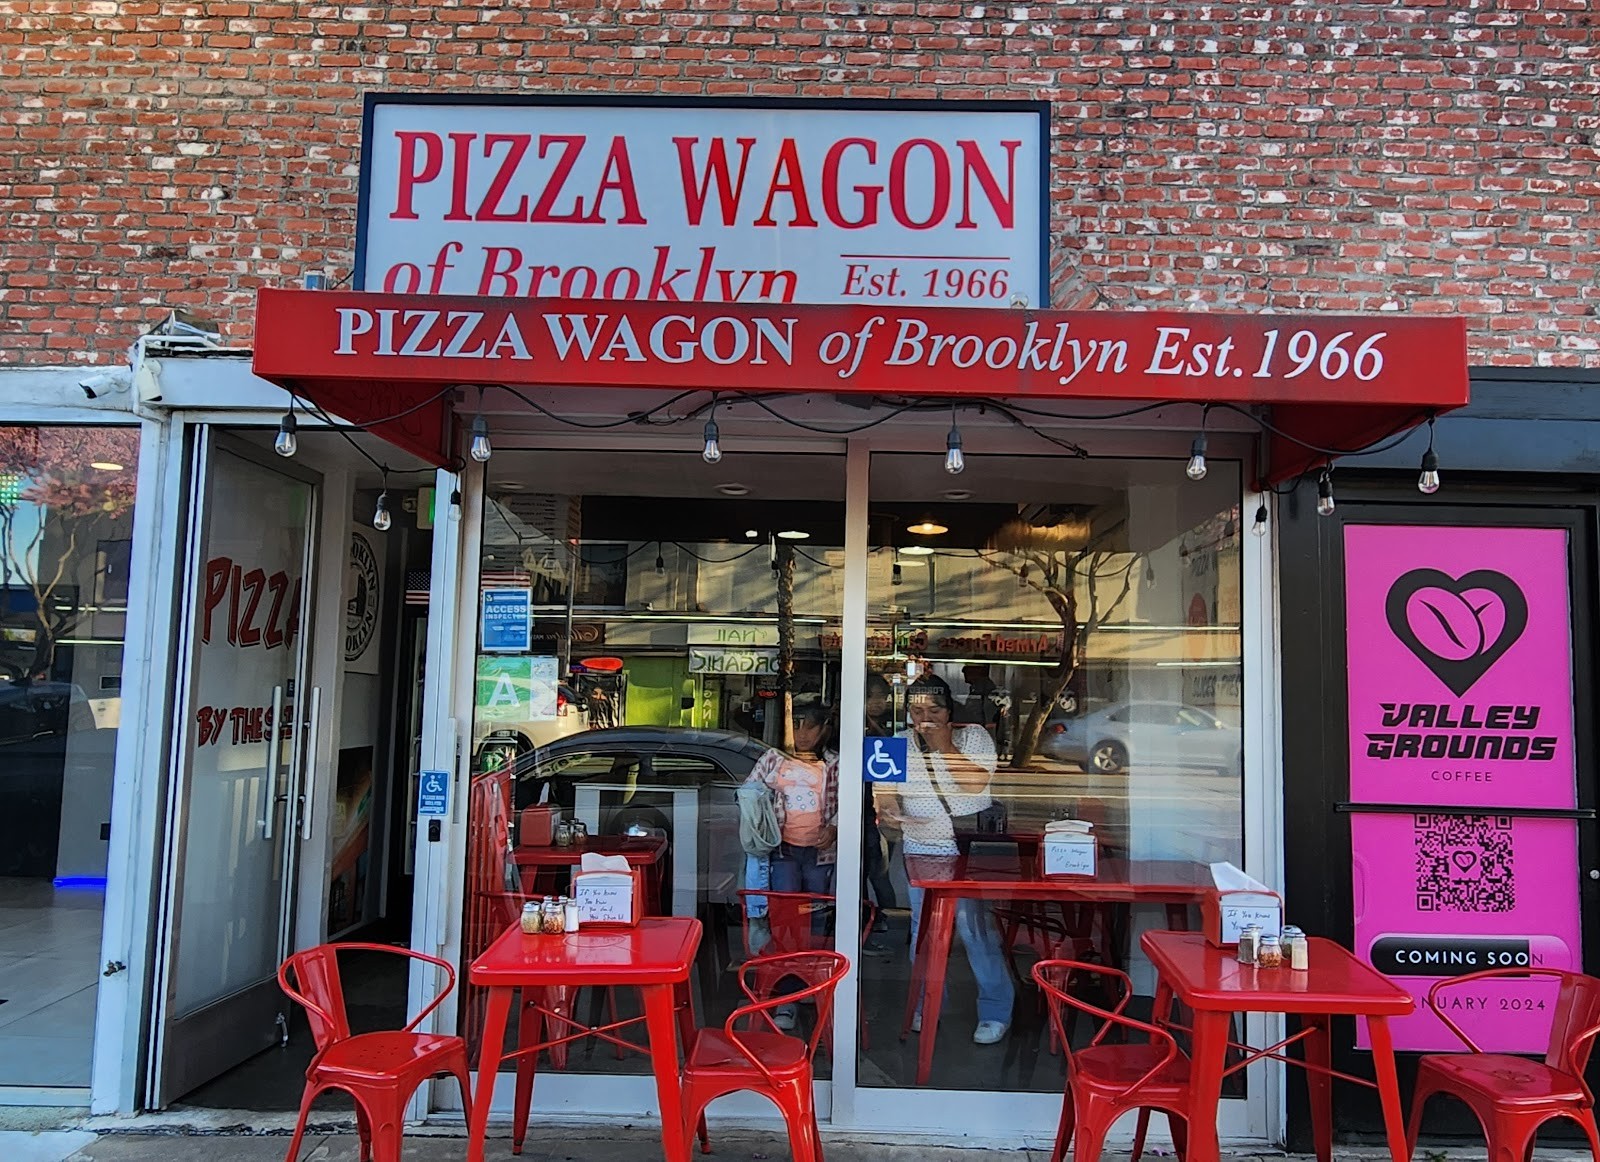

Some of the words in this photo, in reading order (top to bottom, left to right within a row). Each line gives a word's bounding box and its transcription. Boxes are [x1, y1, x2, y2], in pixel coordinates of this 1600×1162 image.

[389, 130, 648, 225] PIZZA
[672, 136, 1022, 230] WAGON
[383, 241, 464, 296] of
[477, 245, 798, 304] Brooklyn
[840, 263, 908, 297] Est.
[921, 267, 1010, 300] 1966
[333, 307, 534, 361] PIZZA
[541, 313, 799, 366] WAGON
[818, 316, 885, 378] of
[884, 317, 1129, 385] Brooklyn
[486, 604, 527, 614] ACCESS
[487, 672, 521, 708] A
[197, 706, 228, 748] BY
[229, 706, 264, 746] THE
[1379, 702, 1541, 730] VALLEY
[1364, 733, 1559, 762] GROUNDS
[1431, 770, 1493, 783] COFFEE
[1394, 950, 1477, 965] COMING
[1487, 951, 1543, 966] SOON
[1412, 996, 1488, 1011] NUARY
[1500, 998, 1546, 1011] 2024
